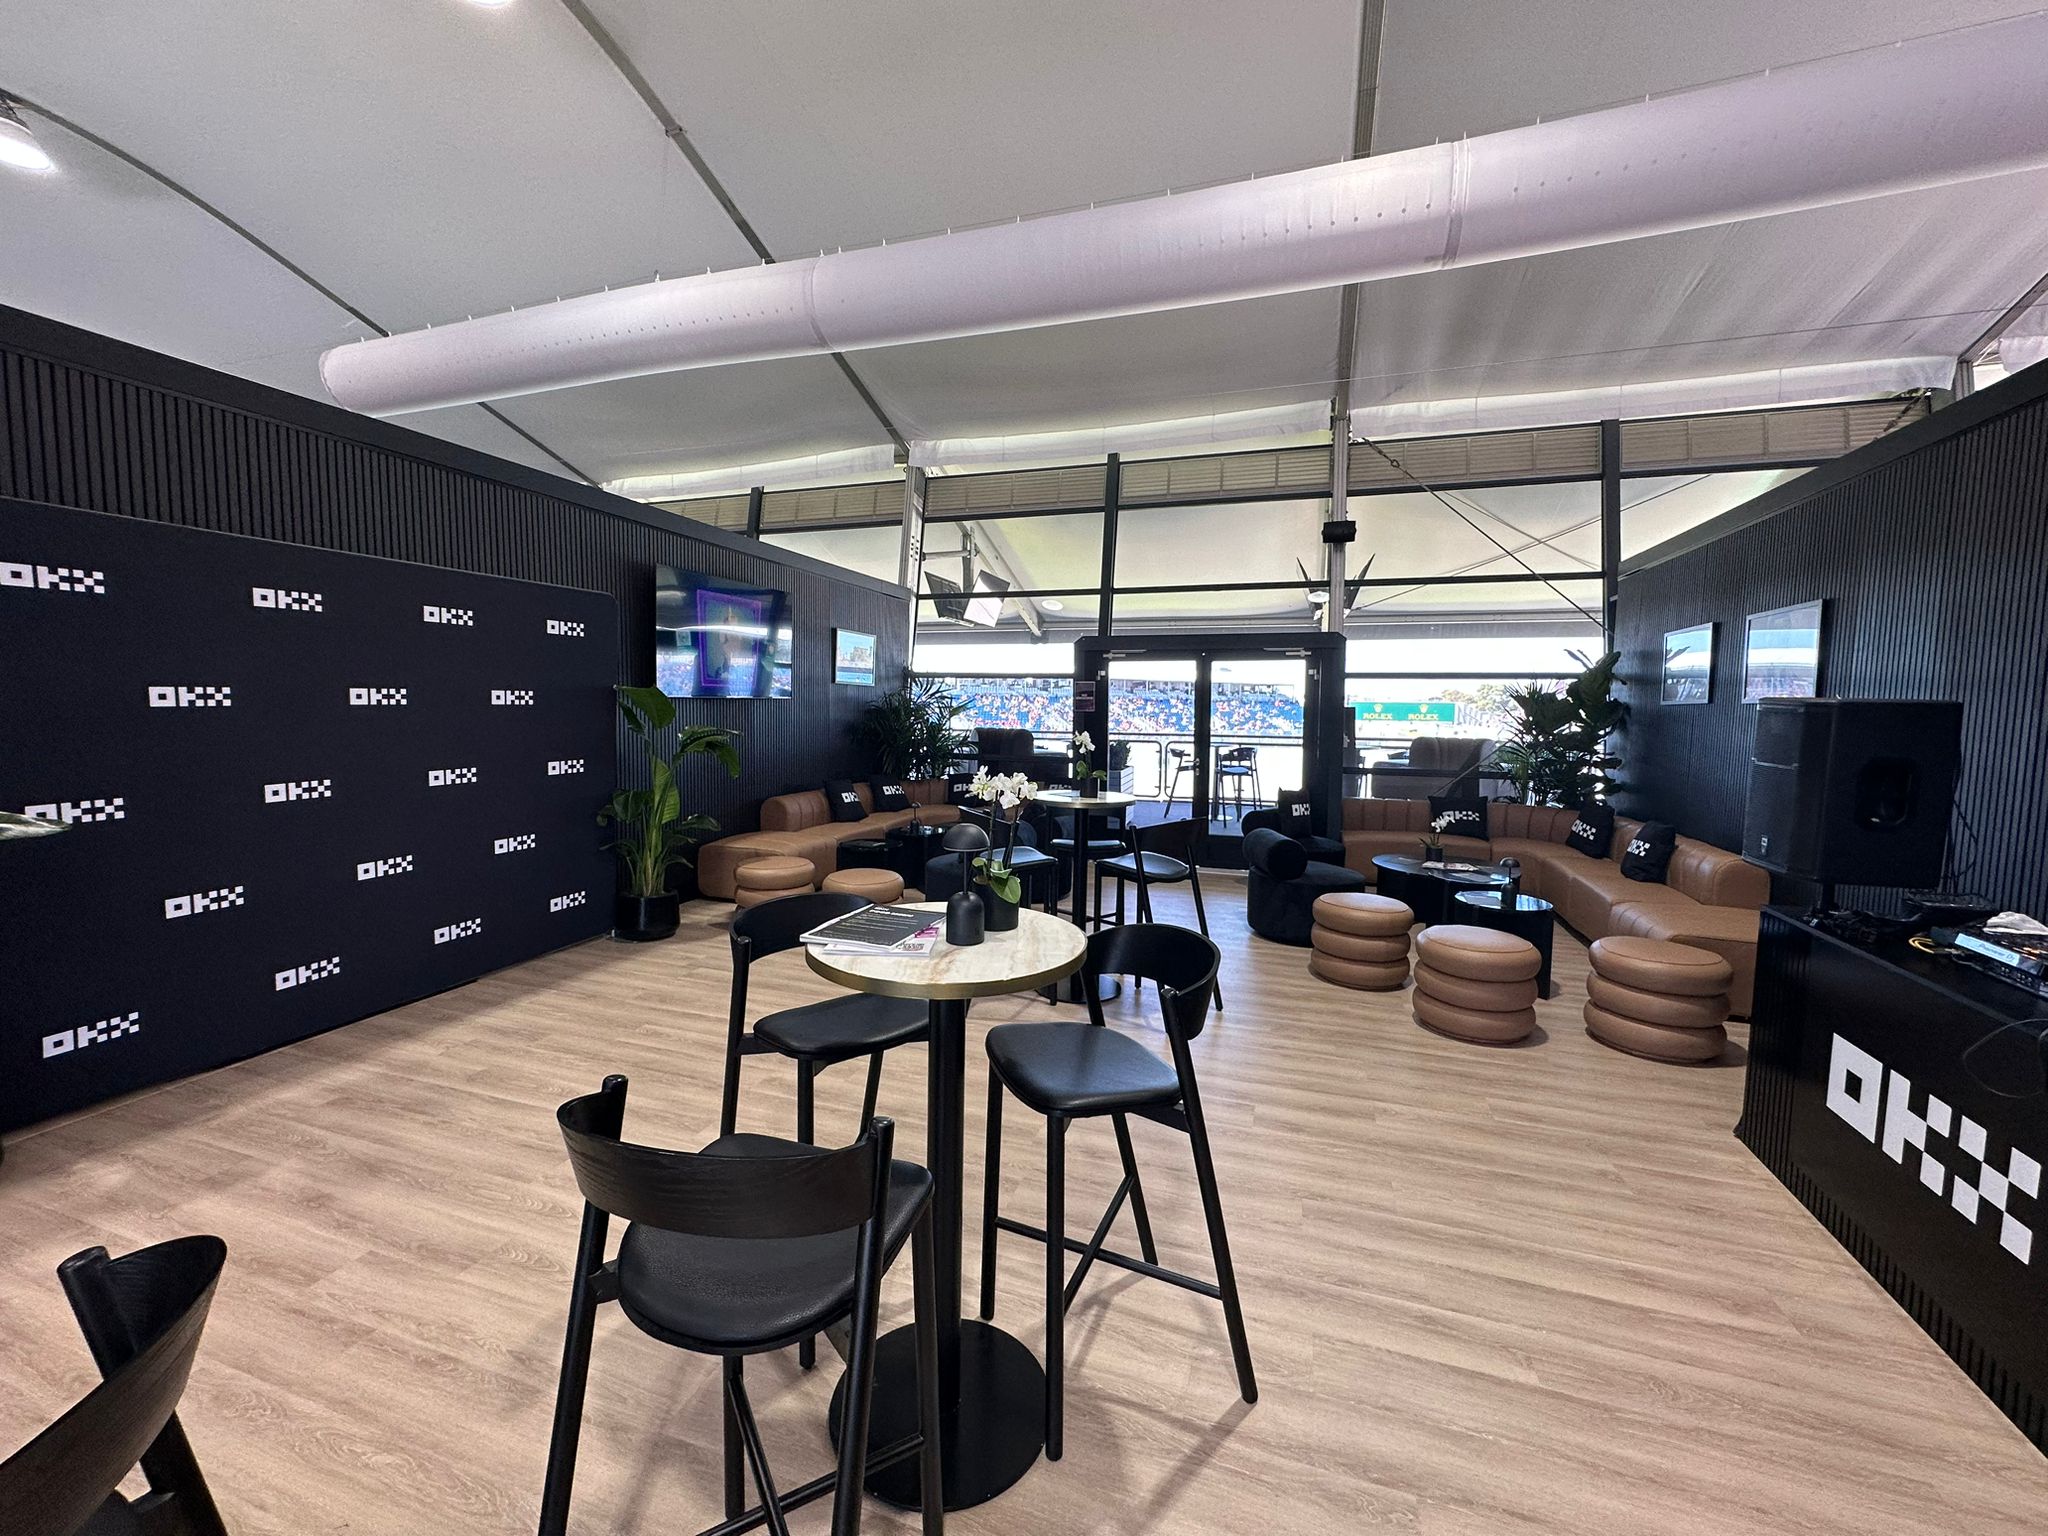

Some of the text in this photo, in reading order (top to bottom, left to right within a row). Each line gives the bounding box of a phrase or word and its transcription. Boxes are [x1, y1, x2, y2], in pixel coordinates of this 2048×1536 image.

[0, 561, 104, 593] OKX
[252, 587, 323, 613] OKX
[423, 605, 474, 627] OKX
[546, 619, 585, 638] OKX
[148, 685, 232, 708] OKX
[349, 687, 408, 706] OKX
[490, 689, 534, 706] OKX
[1362, 712, 1393, 720] ROLEX
[1407, 713, 1439, 721] ROLEX
[428, 767, 477, 787] OKX
[547, 759, 584, 776] OKX
[264, 779, 332, 804] OKX
[841, 792, 860, 804] OK
[1571, 818, 1597, 841] OKX
[494, 833, 536, 855] OKX
[357, 854, 414, 881] OKX
[164, 885, 245, 920] OKX
[550, 890, 586, 913] OKX
[433, 917, 482, 945] OKX
[275, 956, 341, 992] OKX
[42, 1011, 140, 1059] OKX
[1825, 1032, 2043, 1265] OKX
